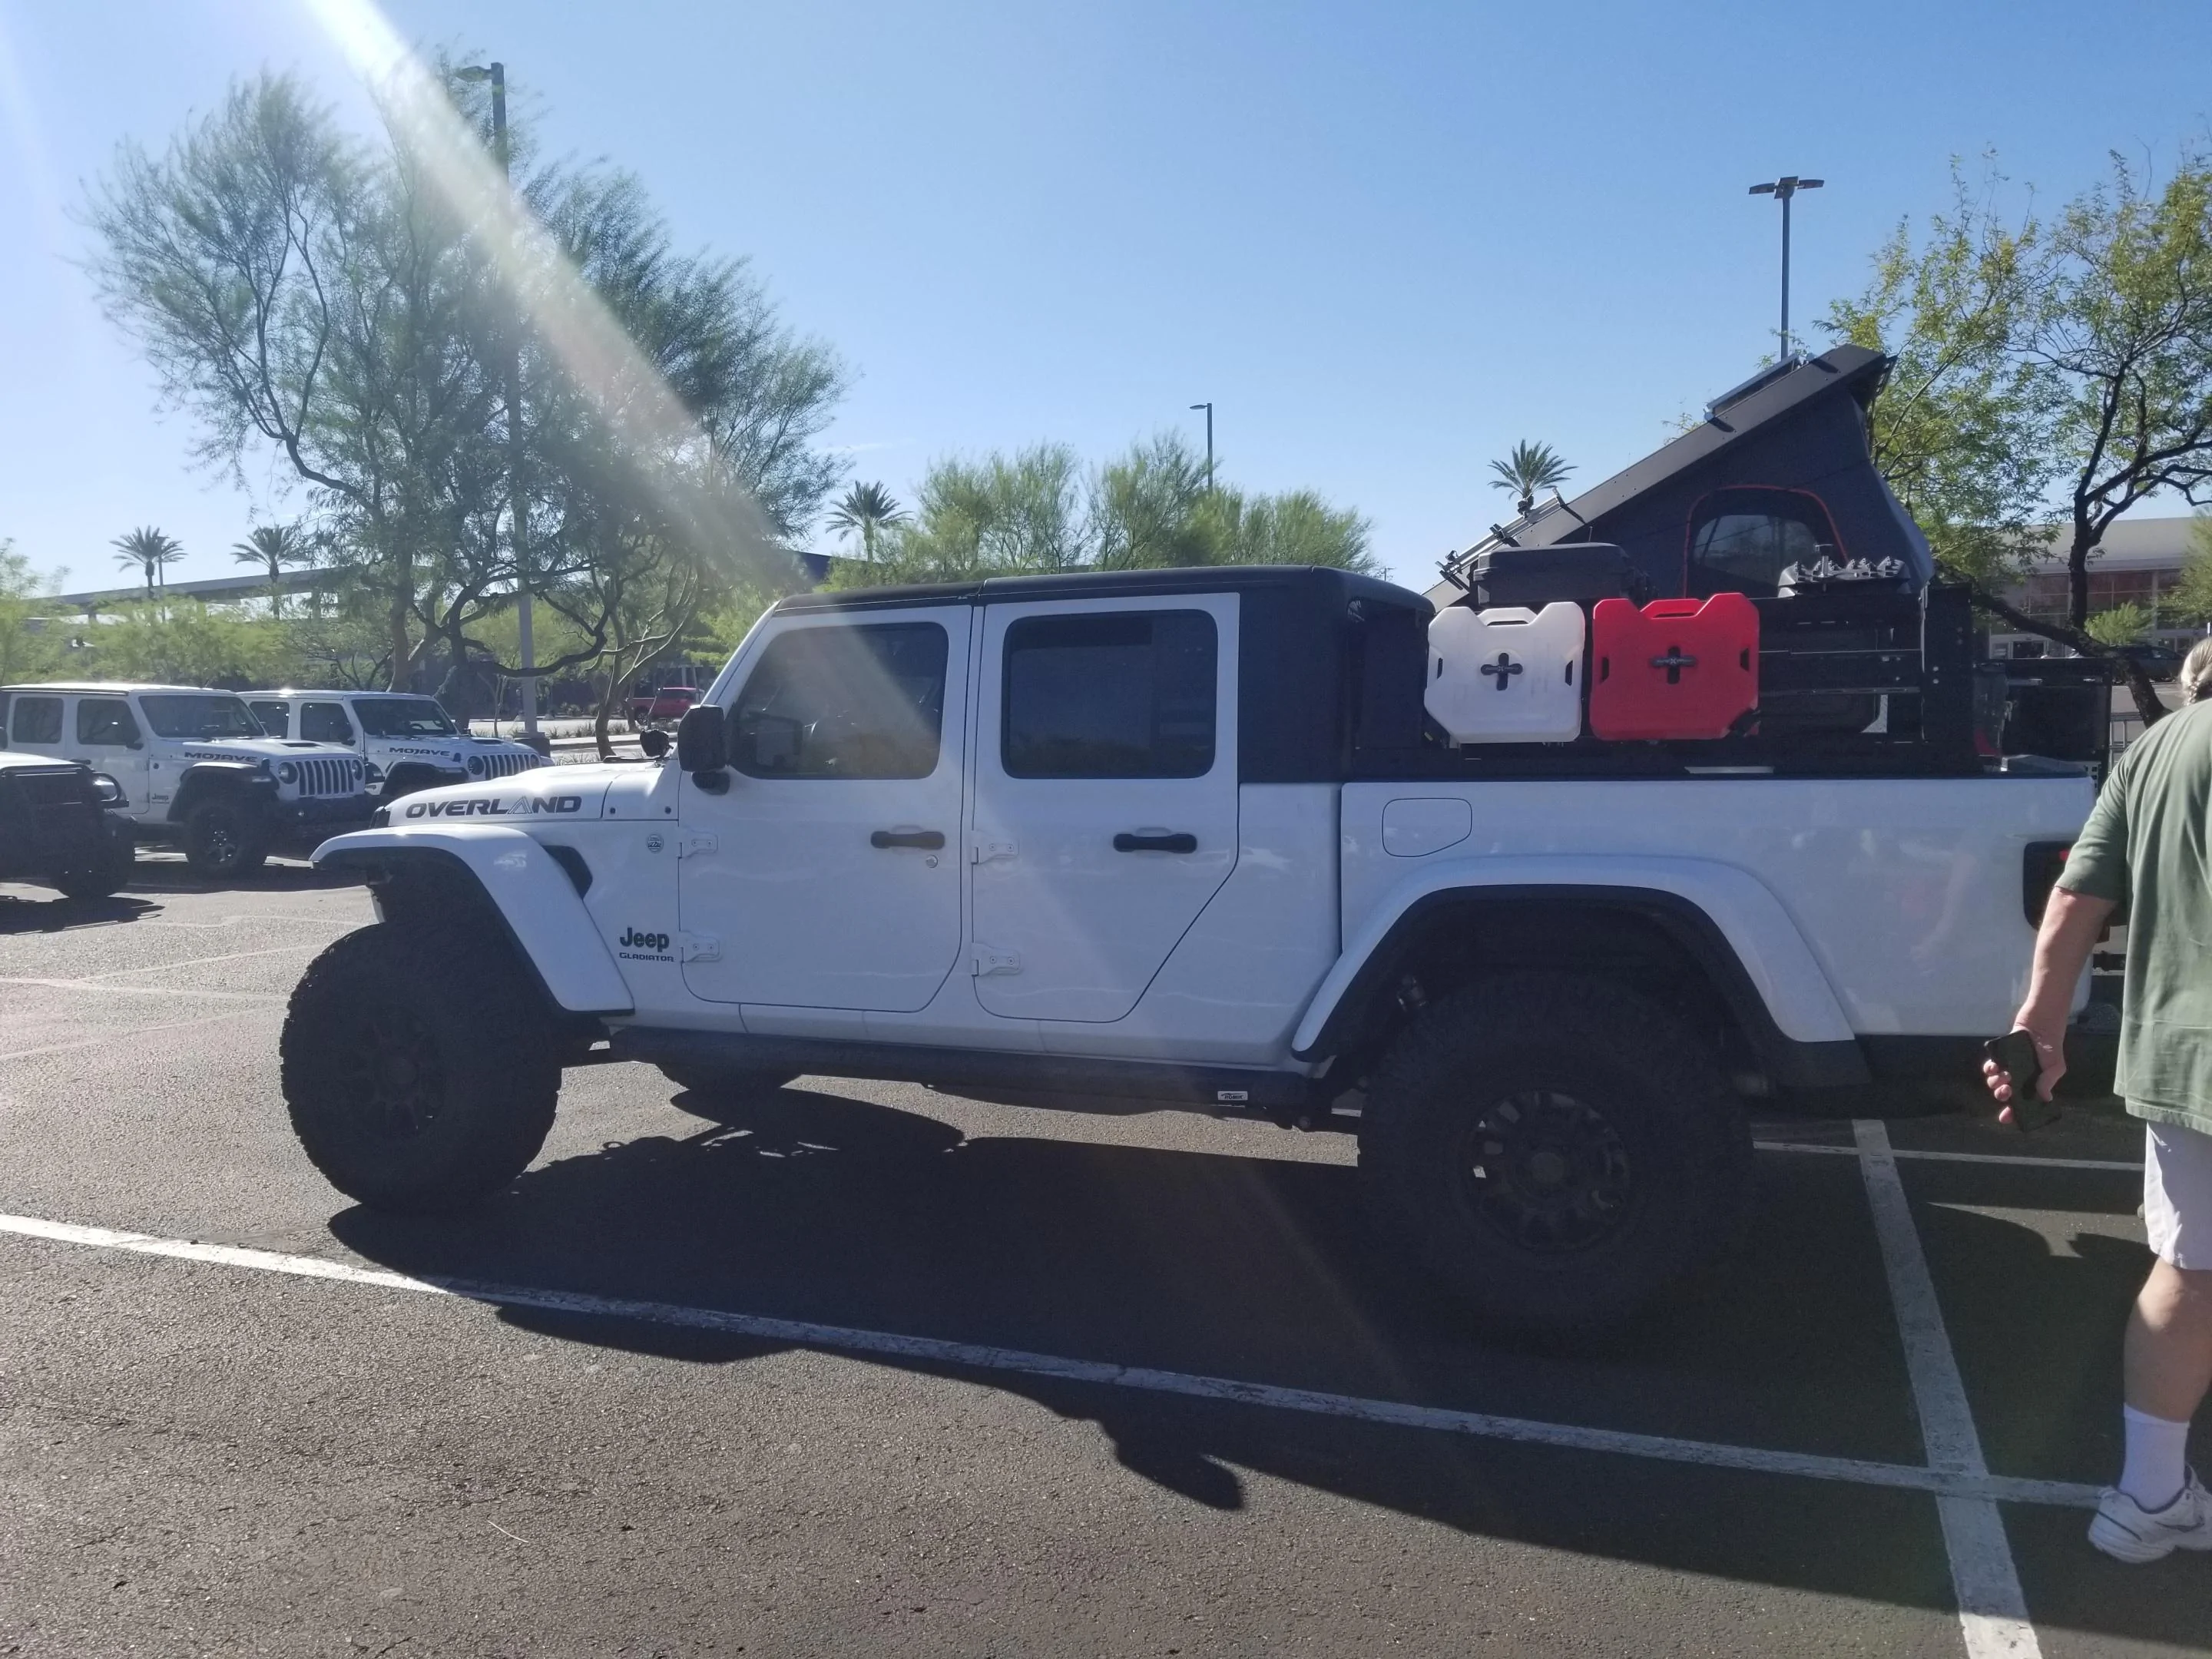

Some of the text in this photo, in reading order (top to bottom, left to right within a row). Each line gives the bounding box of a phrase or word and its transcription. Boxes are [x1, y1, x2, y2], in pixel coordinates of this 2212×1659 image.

[184, 751, 257, 763] MOJAVE
[389, 747, 450, 757] MOJAVE
[405, 796, 582, 819] OVERLAND
[619, 927, 670, 953] Jeep
[619, 952, 676, 962] GLADIATOR
